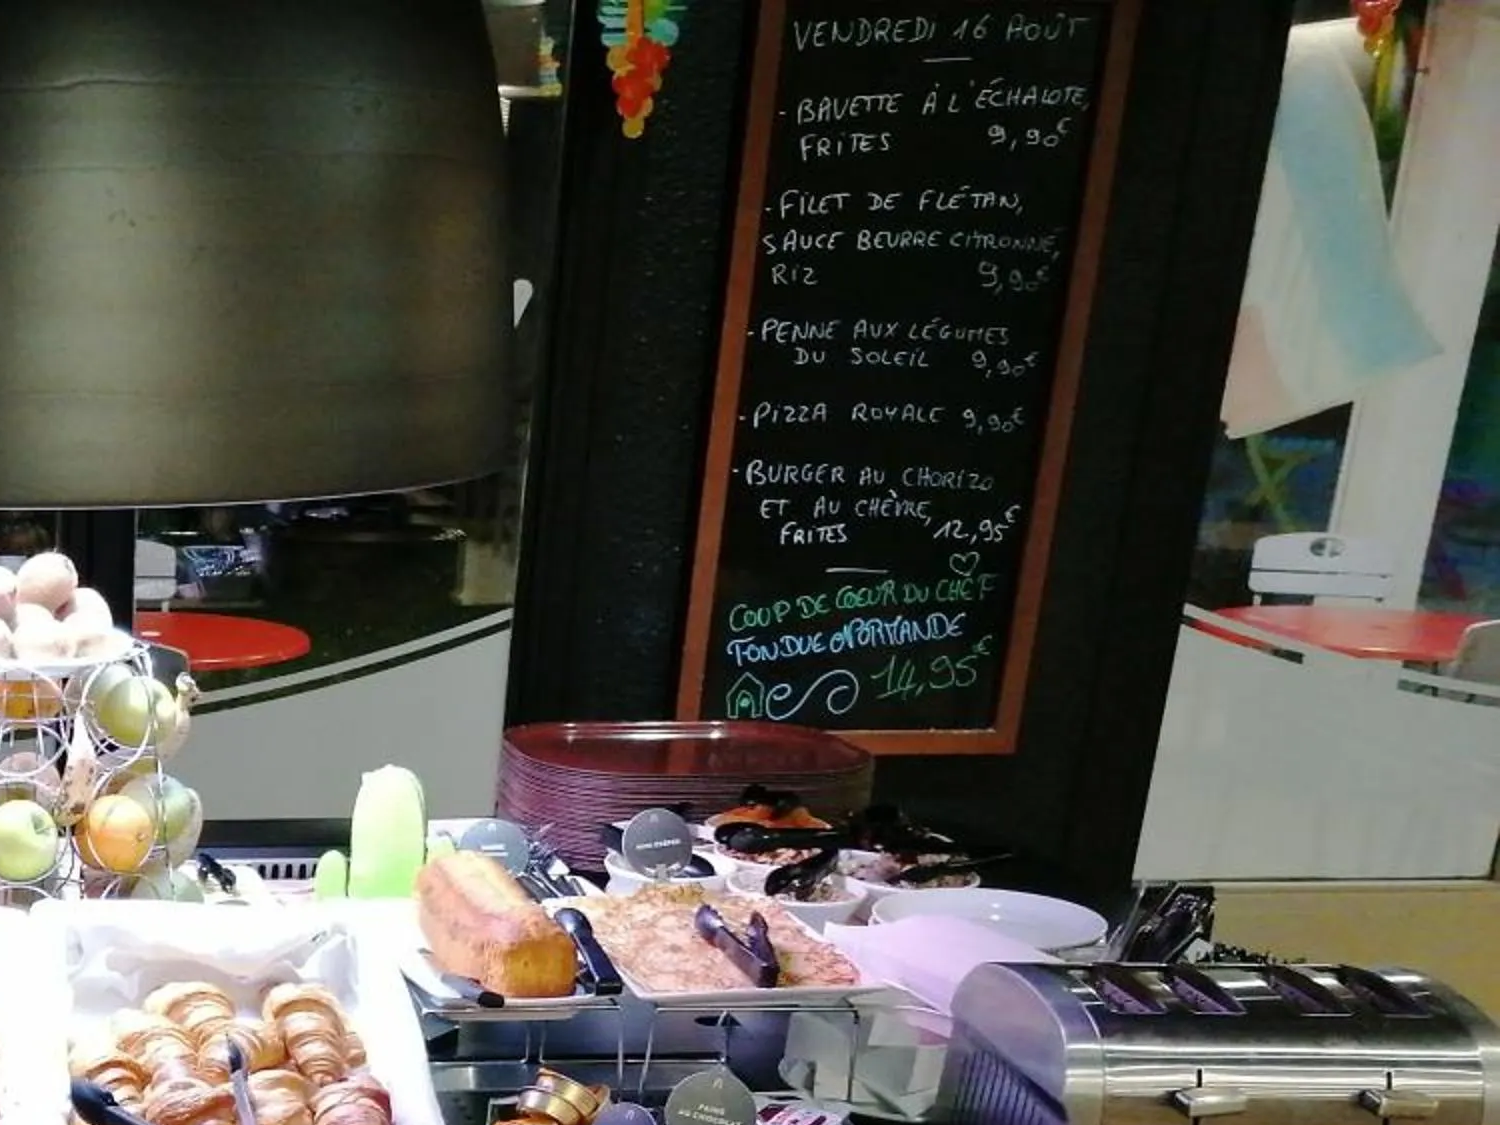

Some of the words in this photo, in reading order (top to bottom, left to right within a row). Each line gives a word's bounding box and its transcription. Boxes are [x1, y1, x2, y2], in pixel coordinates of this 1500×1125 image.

[793, 16, 936, 52] VENDREDI
[952, 12, 994, 41] 16
[1006, 12, 1091, 43] AOÛT
[797, 91, 904, 125] BAVETTE
[799, 131, 892, 163] FRITES
[779, 188, 852, 221] FILET
[867, 191, 902, 212] DE
[761, 228, 845, 256] SAUCE
[856, 228, 944, 251] BEURRE
[760, 316, 842, 344] PENNE
[852, 318, 900, 341] AUX
[907, 315, 1011, 346] LÉGUMES
[793, 346, 826, 366] DU
[850, 346, 930, 368] SOLEIL
[752, 400, 829, 430] PIZZA
[851, 401, 947, 424] ROYALE
[744, 458, 847, 487] BURGER
[858, 465, 886, 488] AU
[900, 464, 996, 493] CHORIZO
[759, 498, 791, 520] ET
[812, 494, 842, 520] AU
[779, 520, 851, 546] FRITES
[729, 600, 792, 633] COUP
[795, 592, 833, 621] DE
[902, 583, 931, 605] DU
[934, 571, 1000, 602] CHEF
